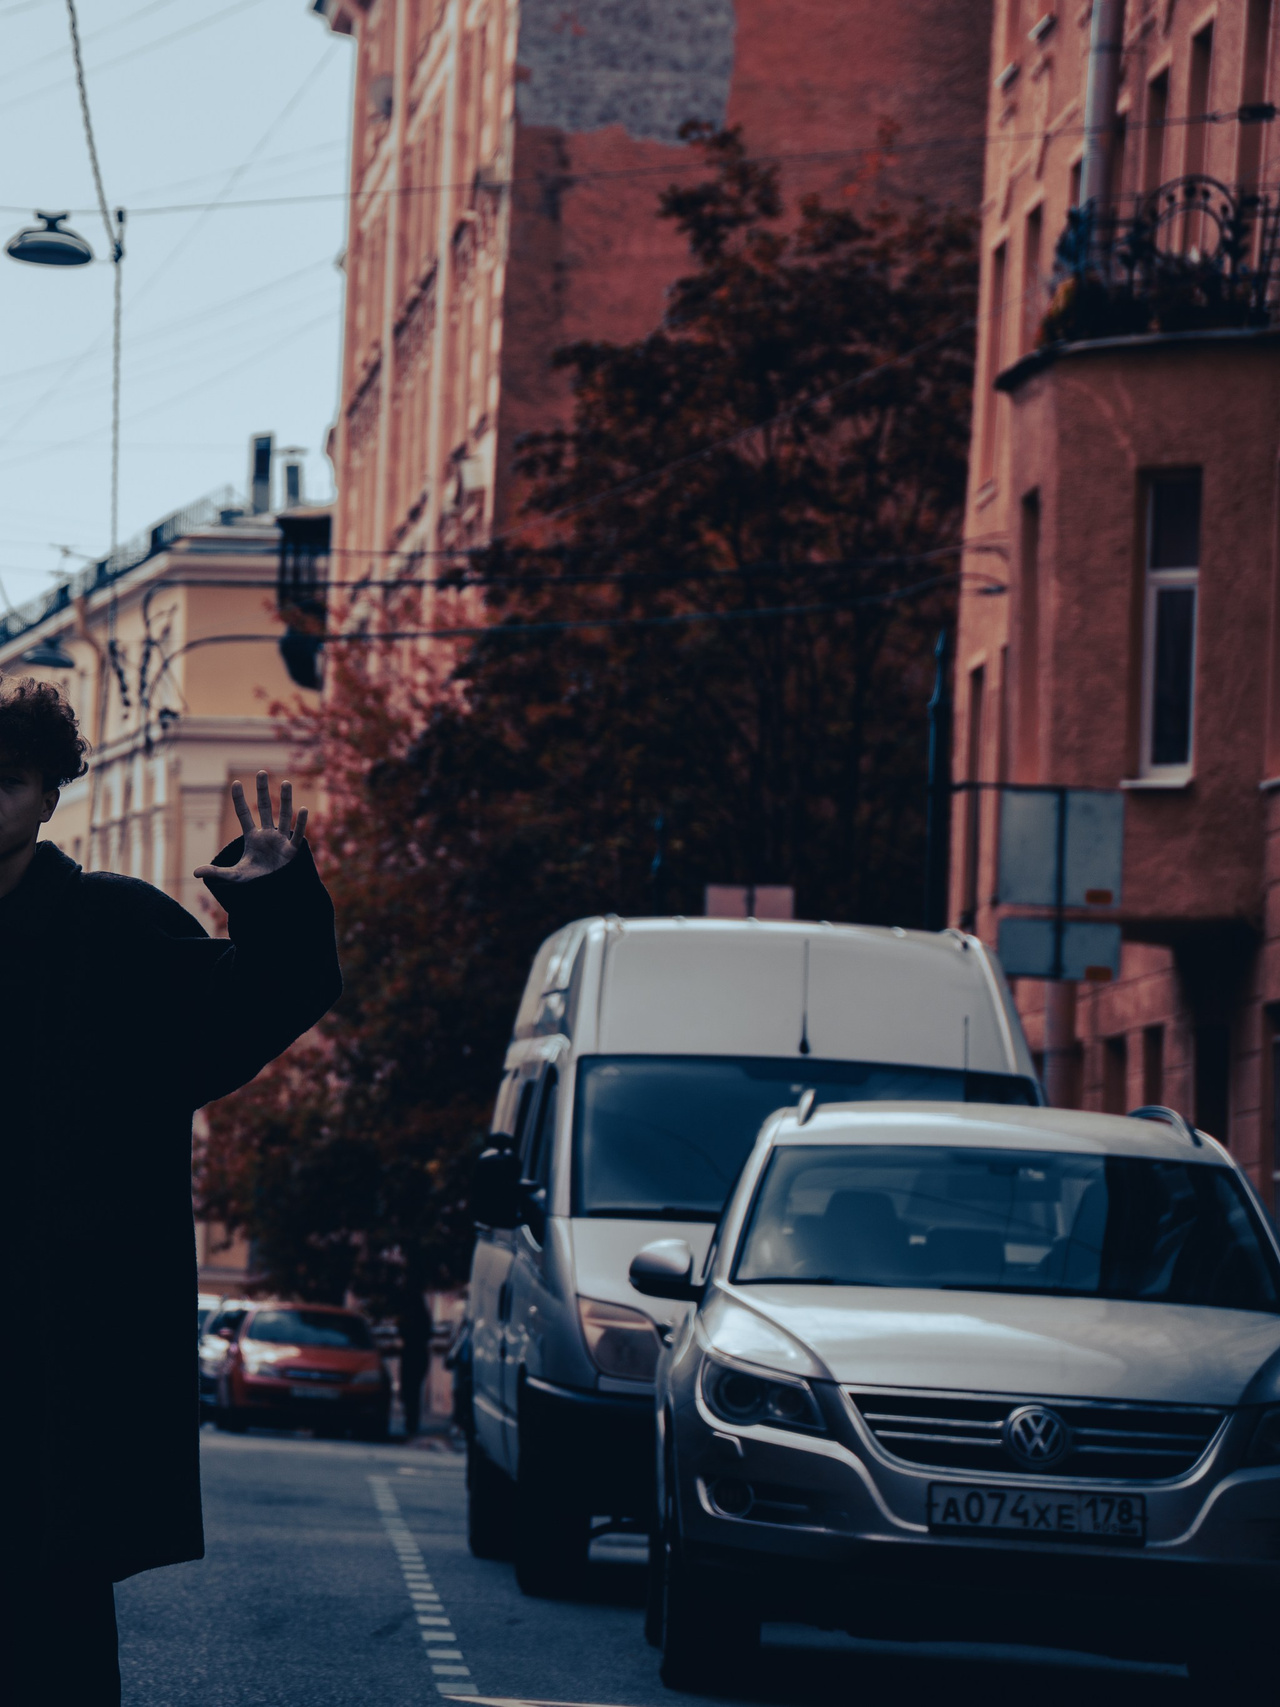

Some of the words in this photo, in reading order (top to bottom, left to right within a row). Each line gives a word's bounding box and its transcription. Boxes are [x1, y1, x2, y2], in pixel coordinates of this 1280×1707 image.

[1011, 1410, 1063, 1461] VW
[942, 1491, 1075, 1530] А074ХЕ
[1085, 1497, 1134, 1524] 178
[1093, 1523, 1120, 1533] RUS
